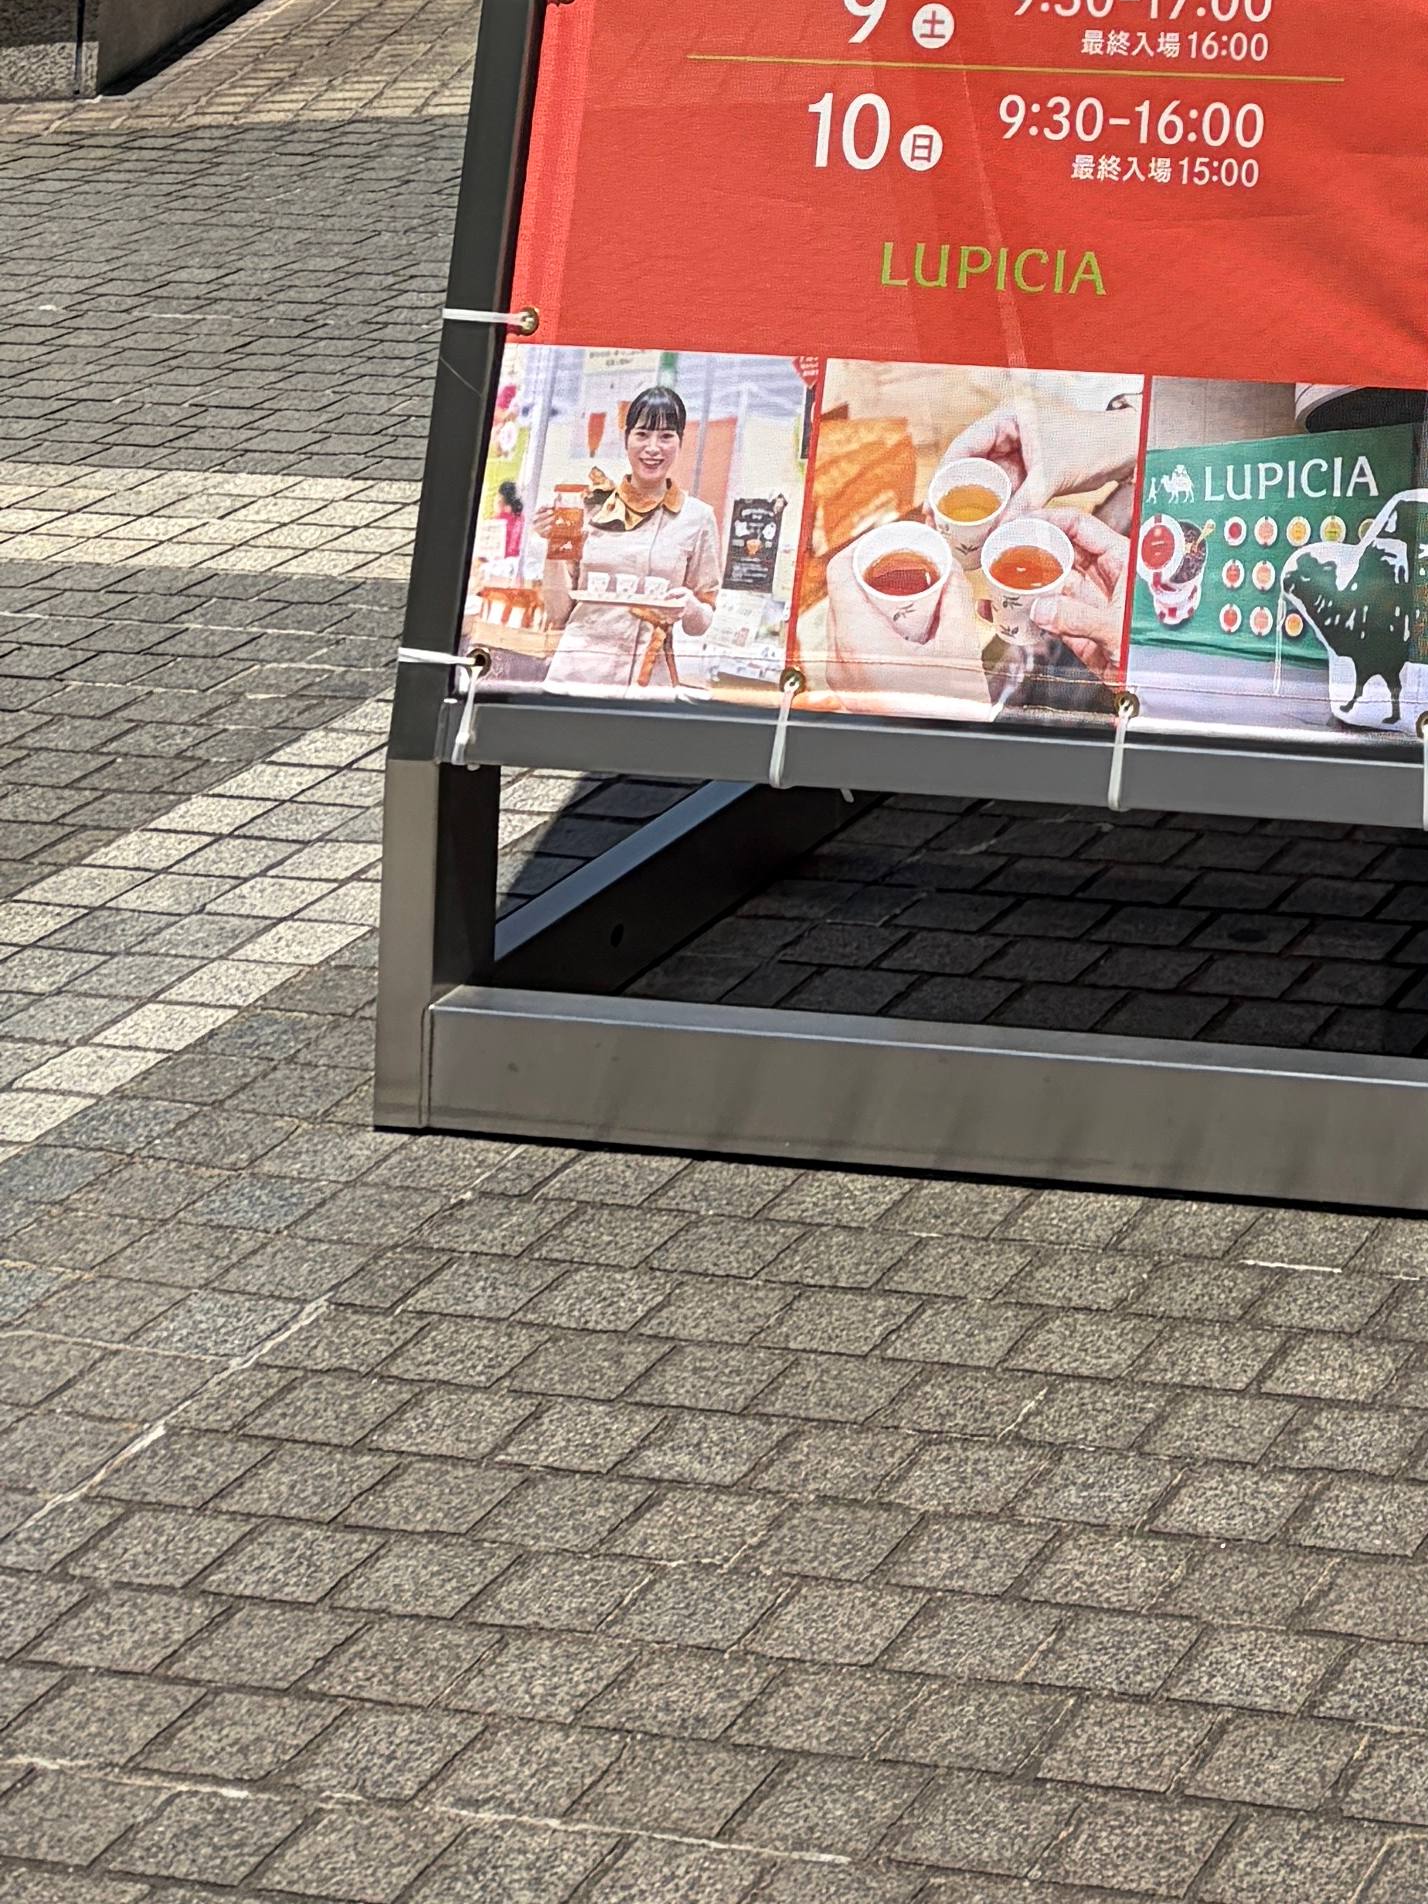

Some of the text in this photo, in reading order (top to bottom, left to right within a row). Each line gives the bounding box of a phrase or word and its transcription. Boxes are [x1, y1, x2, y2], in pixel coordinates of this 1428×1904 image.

[807, 93, 889, 171] 10
[881, 242, 1107, 296] LUPICIA
[1202, 455, 1380, 501] LUPICIA
